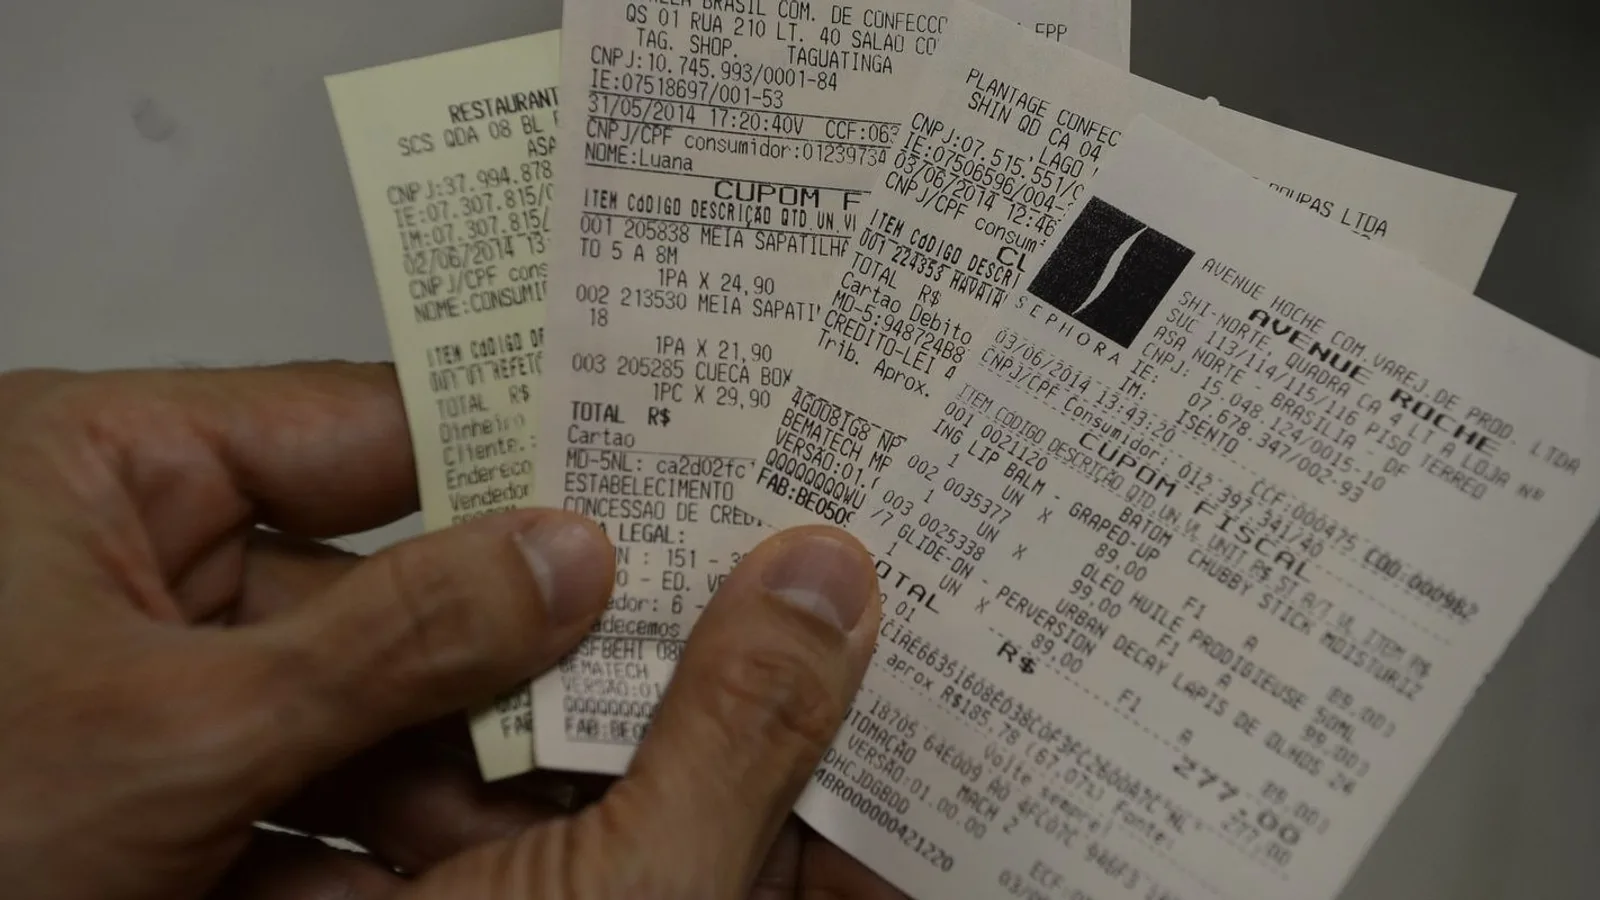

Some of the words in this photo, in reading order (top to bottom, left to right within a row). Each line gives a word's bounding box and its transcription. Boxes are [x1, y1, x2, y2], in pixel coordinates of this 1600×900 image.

[626, 6, 647, 24] QS
[659, 10, 678, 28] 01
[691, 13, 722, 33] RUA
[734, 17, 766, 38] 210
[777, 22, 803, 42] LT.
[820, 27, 840, 46] 40
[852, 30, 904, 52] SALAO
[778, 3, 815, 21] COM.
[832, 7, 852, 25] DE
[637, 27, 672, 50] TAG.
[690, 34, 737, 58] SHOP.
[788, 45, 892, 74] TAGUATINGA
[448, 87, 558, 123] RESTAURANT
[588, 94, 697, 124] 31/05/2014
[592, 68, 783, 109] IE:07518697/001-53
[966, 68, 1050, 118] PLANTAGE
[1057, 109, 1121, 147] CONFEC
[398, 133, 435, 156] SCS
[444, 126, 479, 148] QDA
[488, 120, 512, 140] 08
[521, 115, 544, 135] BL
[587, 119, 673, 145] CNPJ/CPF
[968, 92, 1012, 124] SHIN
[1018, 114, 1041, 136] QD
[1048, 128, 1070, 150] CA
[1079, 141, 1102, 162] 04
[585, 142, 693, 171] NOME:Luana
[387, 160, 553, 205] CNPJ:37.994.878
[714, 178, 819, 208] CUPOM
[886, 171, 968, 219] CNPJ/CPF
[894, 153, 996, 211] 03/06/2014
[1007, 204, 1057, 237] 12:46
[584, 189, 617, 209] ITEM
[691, 199, 770, 227] DESCRIÇÃO
[1341, 208, 1388, 237] LTDA
[580, 213, 614, 236] 001
[624, 217, 691, 243] 205838
[700, 225, 745, 248] MEIA
[581, 237, 600, 258] TO
[612, 240, 622, 260] 5
[634, 244, 644, 262] A
[656, 245, 677, 264] 8M
[870, 209, 904, 238] ITEM
[967, 254, 1020, 289] DESCRI
[659, 268, 687, 288] 1PA
[699, 272, 709, 290] X
[721, 273, 774, 296] 24,90
[852, 251, 896, 289] TOTAL
[918, 284, 941, 306] R$
[891, 244, 946, 282] 224353
[1202, 258, 1265, 300] AVENUE
[576, 284, 610, 304] 002
[620, 287, 686, 310] 213530
[698, 294, 741, 315] MEIA
[590, 308, 608, 327] 18
[841, 272, 901, 313] Cartao
[909, 303, 972, 345] Debito
[824, 310, 936, 374] CREDITO-LEI
[832, 290, 965, 363] MD-5:948724B8
[1015, 296, 1119, 365] SEPHORA
[572, 352, 606, 374] 003
[617, 356, 684, 379] 205285
[696, 362, 749, 384] CUECA
[761, 366, 792, 387] BOX
[656, 336, 684, 356] 1PA
[697, 339, 706, 357] X
[718, 340, 772, 363] 21,90
[818, 328, 858, 365] Trib.
[873, 358, 929, 397] Aprox.
[995, 330, 1090, 394] 03/06/2014
[1096, 390, 1176, 442] 13:43:20
[1130, 360, 1158, 383] IE:
[1166, 308, 1198, 333] SUC
[1205, 330, 1358, 426] 113/114/115/116
[1364, 422, 1412, 456] PISO
[1248, 309, 1362, 379] AVENUE
[1390, 388, 1489, 451] ROCHE
[572, 401, 624, 423] TOTAL
[648, 407, 670, 427] R$
[654, 382, 682, 402] 1PC
[695, 385, 705, 403] X
[716, 387, 770, 409] 29,90
[958, 383, 994, 412] ITEM
[981, 348, 1060, 398] CNPJ/CPF
[1064, 396, 1167, 465] Consumidor:
[1118, 376, 1146, 400] IM:
[1175, 410, 1239, 454] ISENTO
[1142, 342, 1189, 377] CNPJ:
[1200, 376, 1385, 490] 15.048.124/0015-10
[1153, 326, 1186, 351] ASA
[1192, 348, 1245, 384] NORTE
[1270, 392, 1356, 449] BRASILIA
[1382, 457, 1410, 477] DF
[568, 425, 635, 448] Cartao
[781, 408, 863, 462] BEMATECH
[868, 451, 892, 472] MP
[1285, 352, 1350, 397] QUADRA
[1356, 393, 1382, 415] CA
[1390, 413, 1402, 426] 4
[1440, 442, 1456, 458] A
[1460, 454, 1510, 487] LOJA
[566, 448, 642, 472] MD-5NL:
[877, 430, 904, 453] NP
[564, 472, 734, 500] ESTABELECIMENTO
[908, 455, 939, 481] 002
[944, 478, 1011, 524] 0035377
[933, 419, 963, 444] ING
[968, 440, 1000, 464] LIP
[1004, 462, 1046, 495] BALM
[1069, 502, 1160, 561] GRAPED-UP
[1079, 432, 1176, 497] CUPOM
[1193, 500, 1306, 579] FISCAL
[676, 502, 698, 522] DE
[944, 402, 974, 428] 001
[981, 424, 1048, 471] 0021120
[1118, 507, 1172, 547] BATOM
[1188, 549, 1252, 595] CHUBBY
[1258, 593, 1314, 635] STICK
[619, 523, 684, 544] LEGAL:
[1002, 485, 1025, 507] UN
[1094, 542, 1147, 581] 89.00
[668, 548, 696, 568] 151
[976, 520, 1000, 543] UN
[1069, 579, 1121, 618] 99.00
[662, 570, 690, 590] ED.
[870, 509, 894, 526] /7
[898, 524, 974, 579] GLIDE-ON
[996, 585, 1096, 656] PERVERSION
[882, 490, 914, 516] 003
[918, 513, 985, 561] 0025338
[1056, 598, 1108, 639] URBAN
[1112, 634, 1168, 674] DECAY
[672, 595, 683, 614] 6
[895, 601, 916, 622] 01
[939, 574, 962, 596] UN
[1031, 633, 1083, 673] 89.00
[886, 654, 934, 690] aprox
[997, 642, 1036, 674] R$
